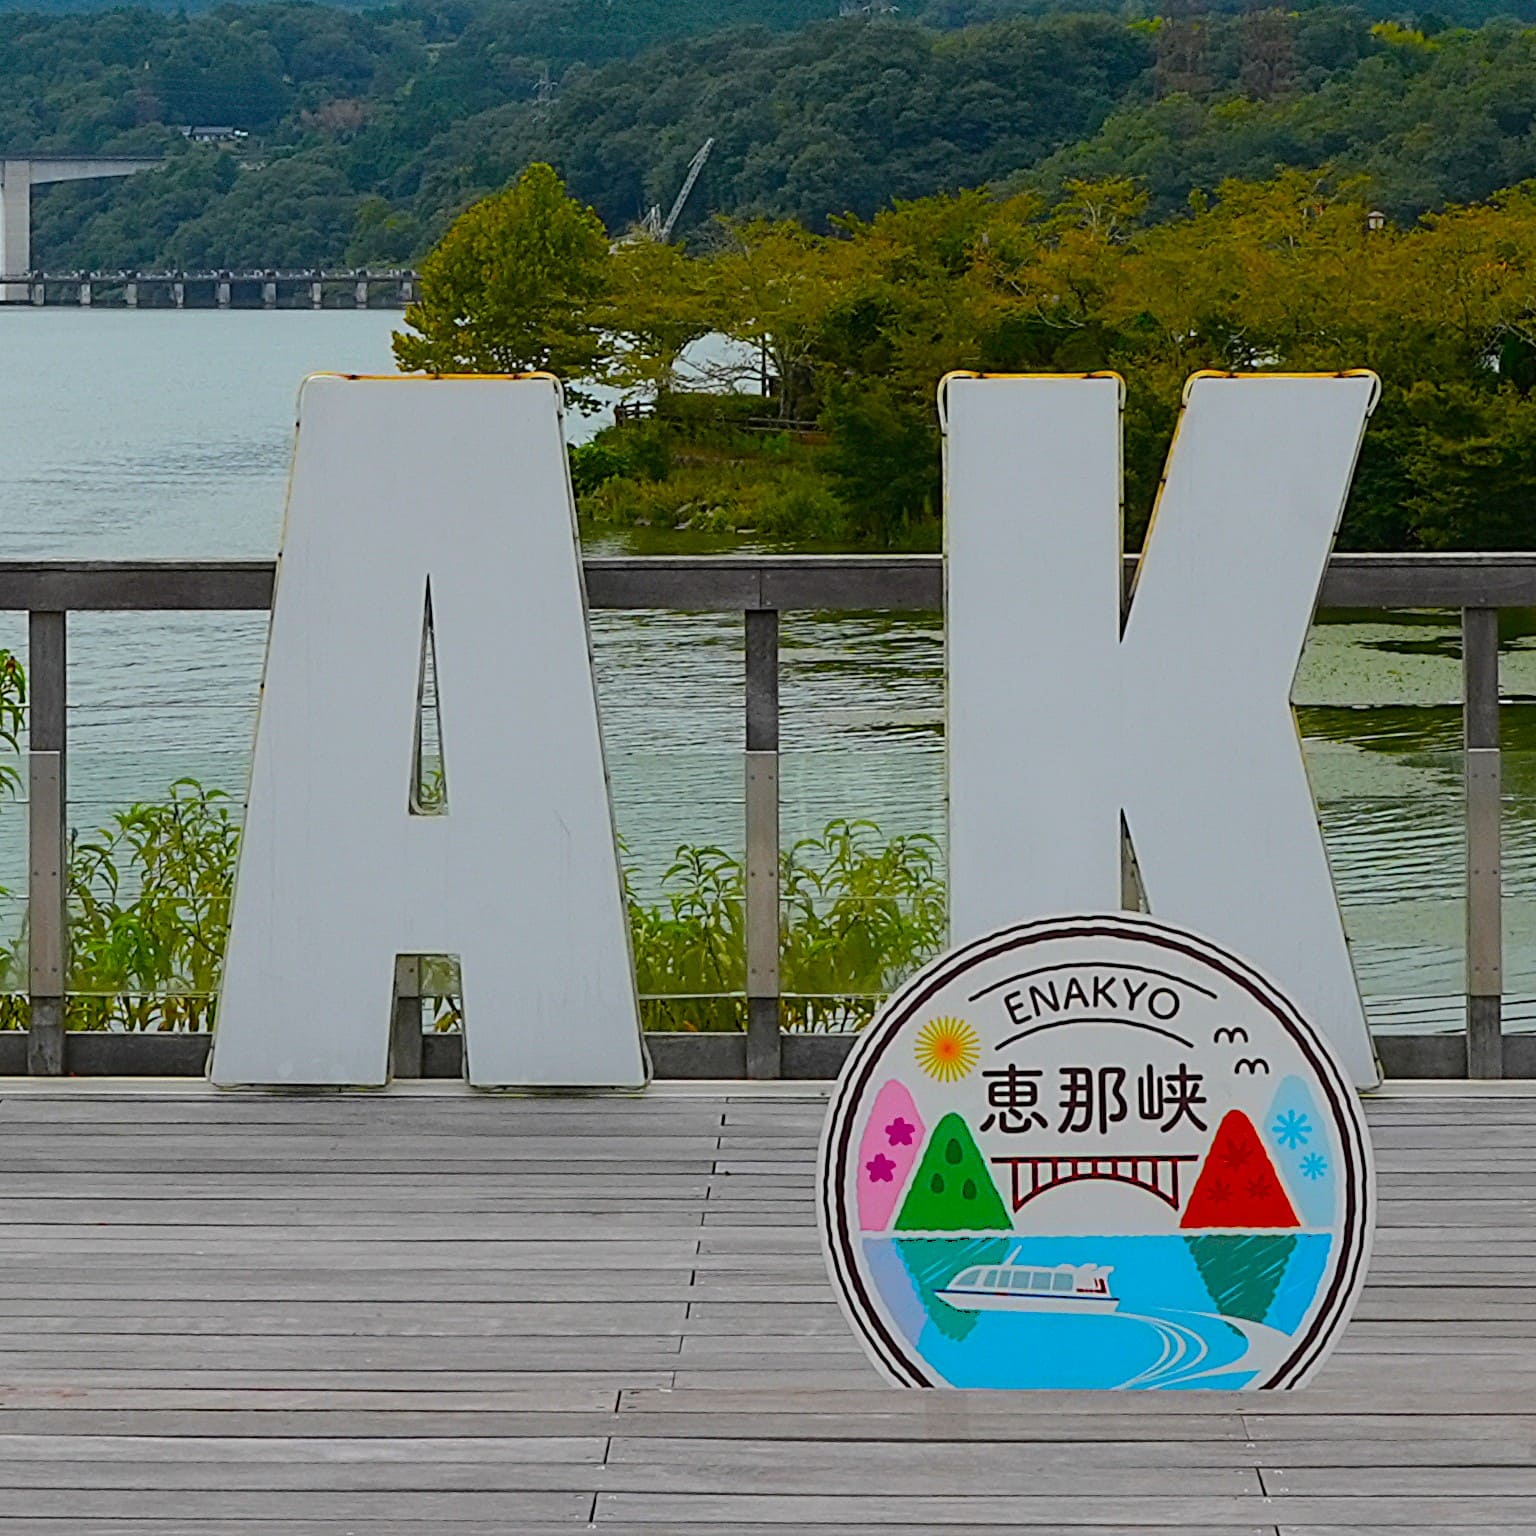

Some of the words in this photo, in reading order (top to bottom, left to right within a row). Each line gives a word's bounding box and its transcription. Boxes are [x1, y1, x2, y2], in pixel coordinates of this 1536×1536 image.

[1004, 976, 1180, 1024] ENAKYO
[980, 1063, 1208, 1135] 恵那峡
